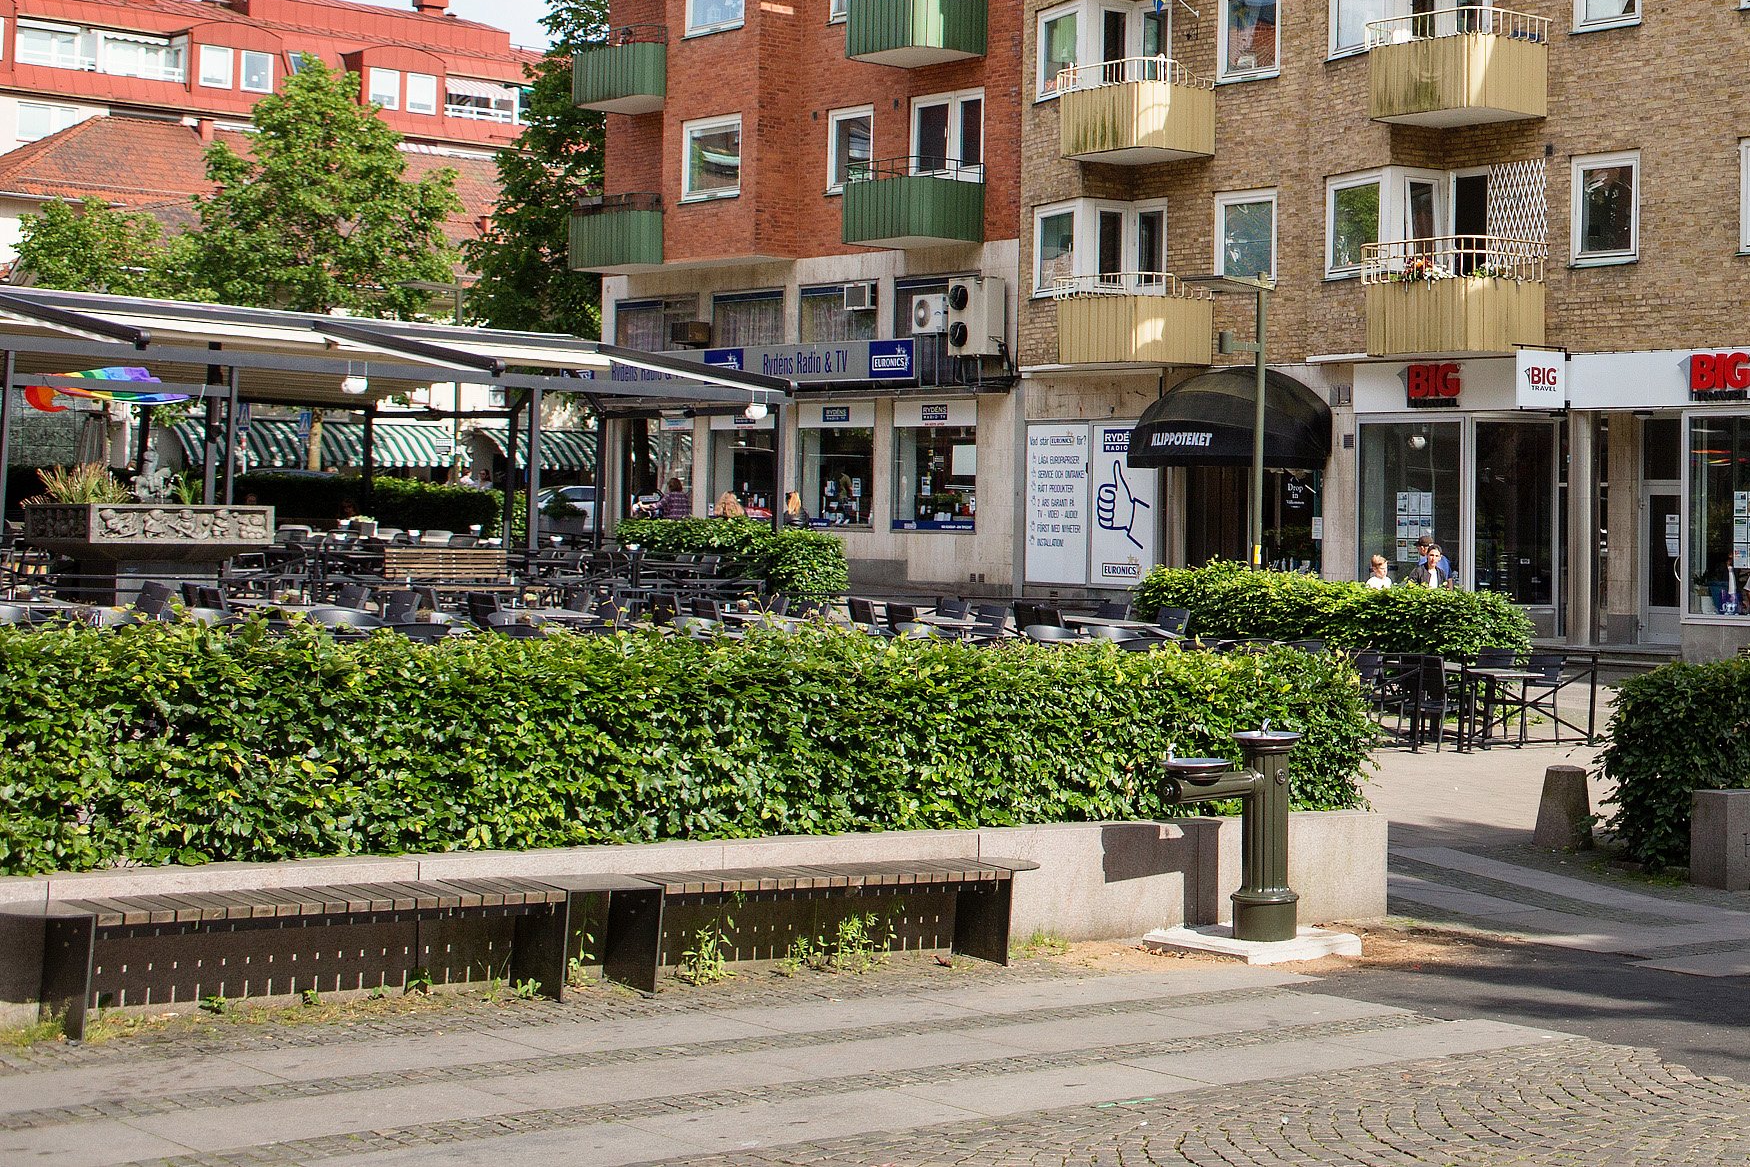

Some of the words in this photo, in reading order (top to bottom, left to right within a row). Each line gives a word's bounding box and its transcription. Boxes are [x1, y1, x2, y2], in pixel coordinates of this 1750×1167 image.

[763, 352, 794, 375] Rydéns
[797, 351, 821, 374] Radio
[825, 351, 833, 372] &
[836, 350, 848, 372] TV
[874, 357, 905, 368] EURONICS
[1408, 363, 1461, 397] BIG
[1531, 366, 1557, 385] BIG
[1105, 431, 1131, 442] RYDÉ
[1151, 432, 1213, 447] KLIPPOTEKET
[1288, 483, 1304, 493] Drop
[1104, 565, 1137, 575] EURONICS
